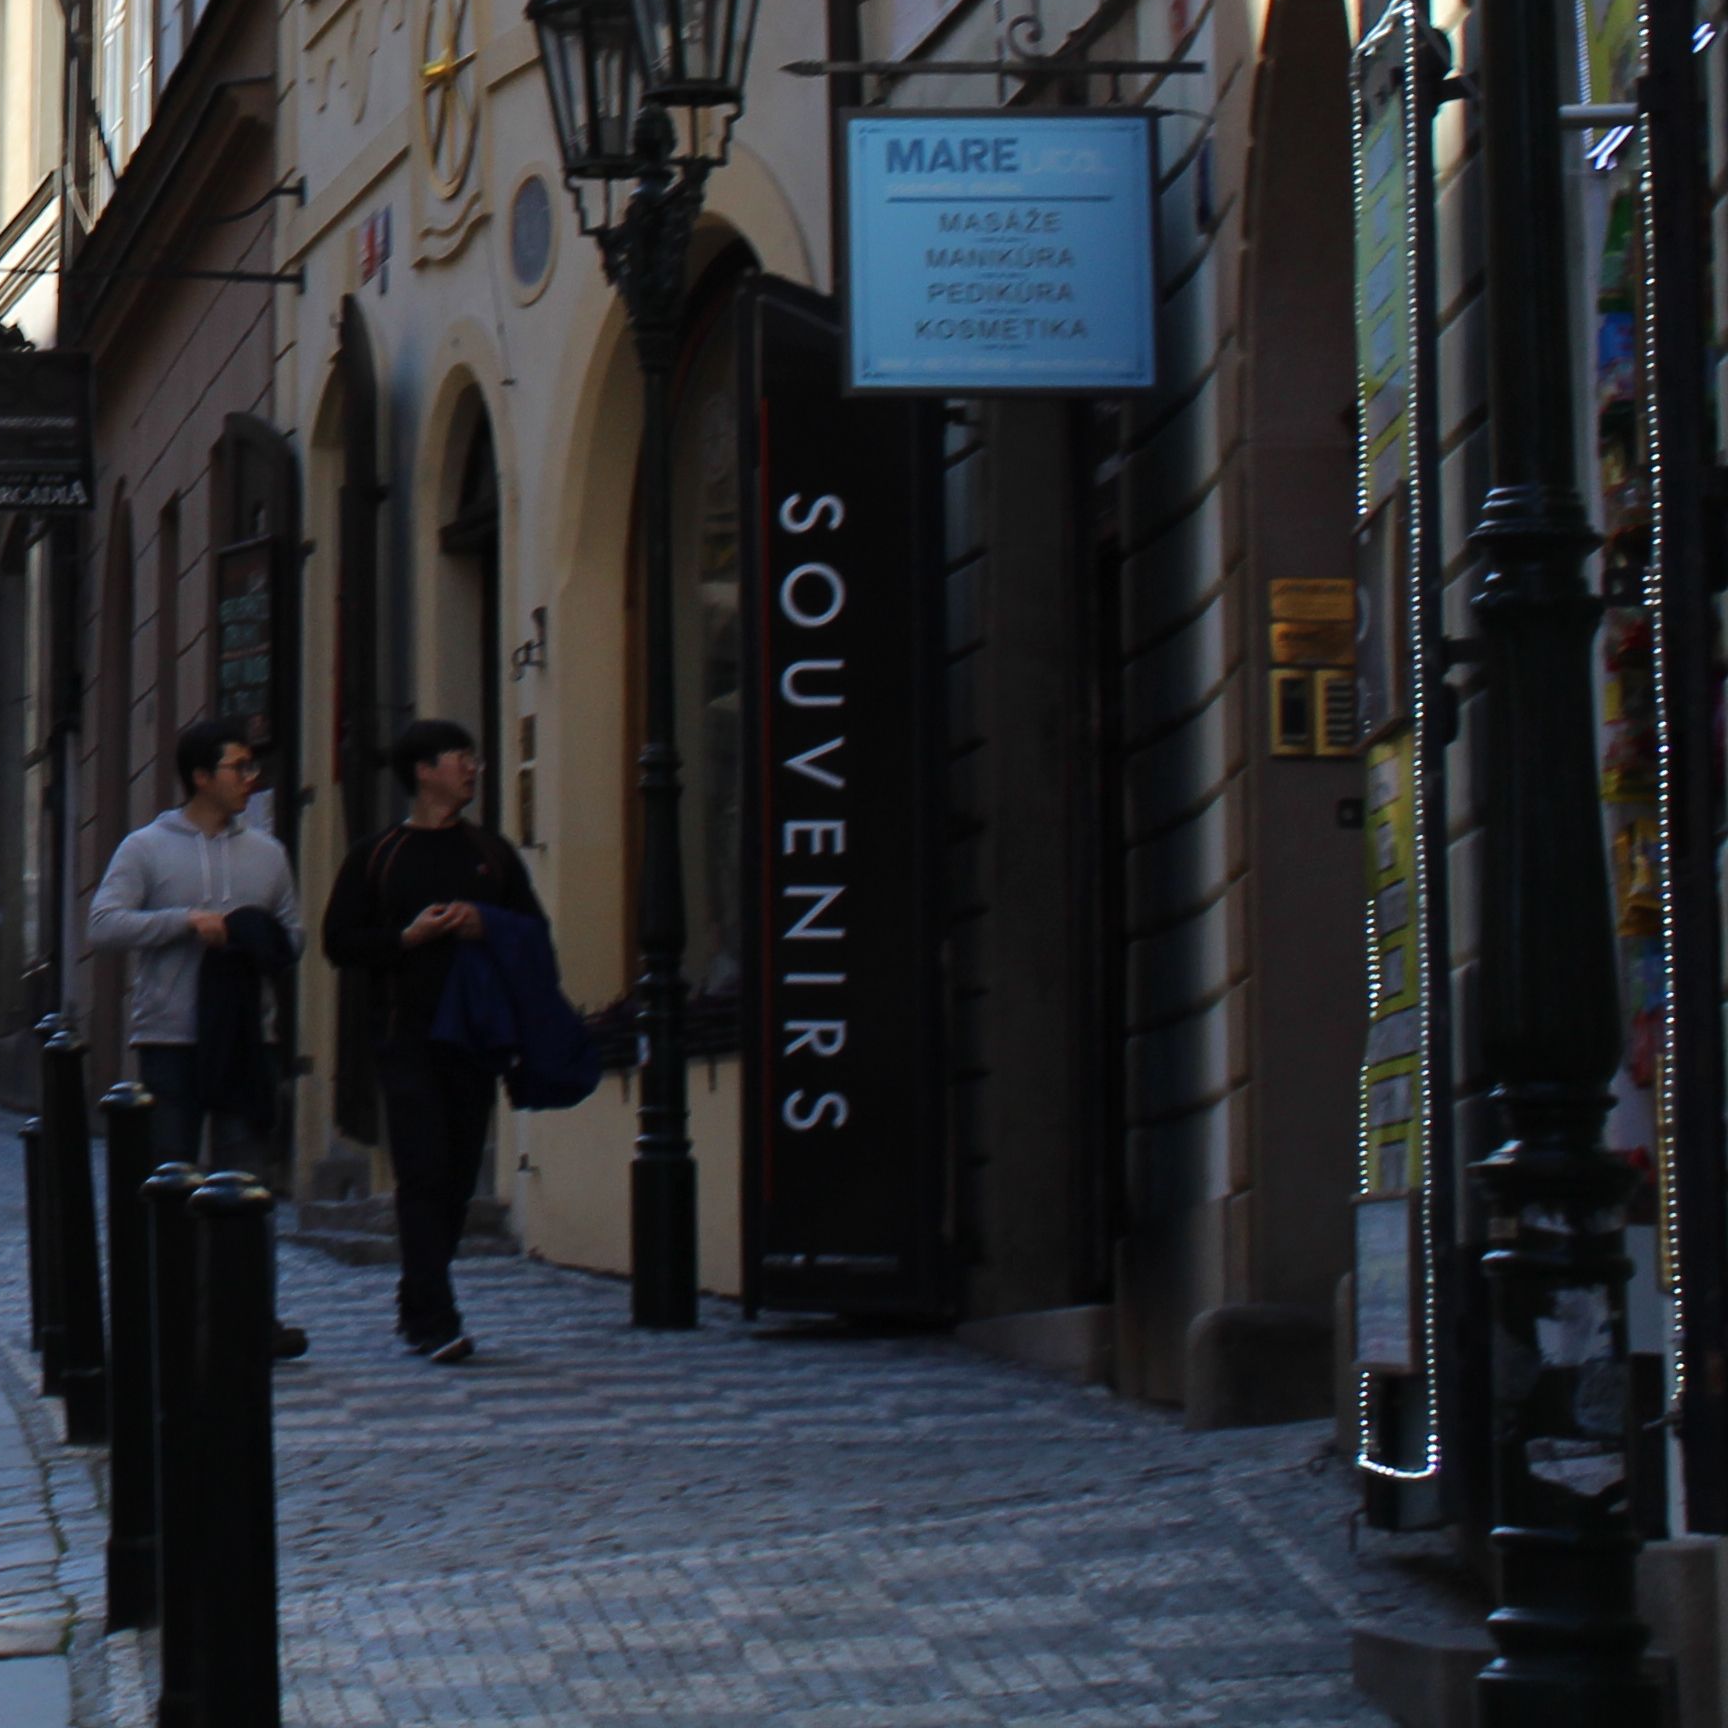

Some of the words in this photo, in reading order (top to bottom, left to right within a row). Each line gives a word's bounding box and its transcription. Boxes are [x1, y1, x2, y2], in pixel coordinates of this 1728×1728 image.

[885, 137, 1020, 174] MARE
[914, 318, 1089, 341] KOSMETIKA
[777, 490, 849, 1133] SOUVENIRS
